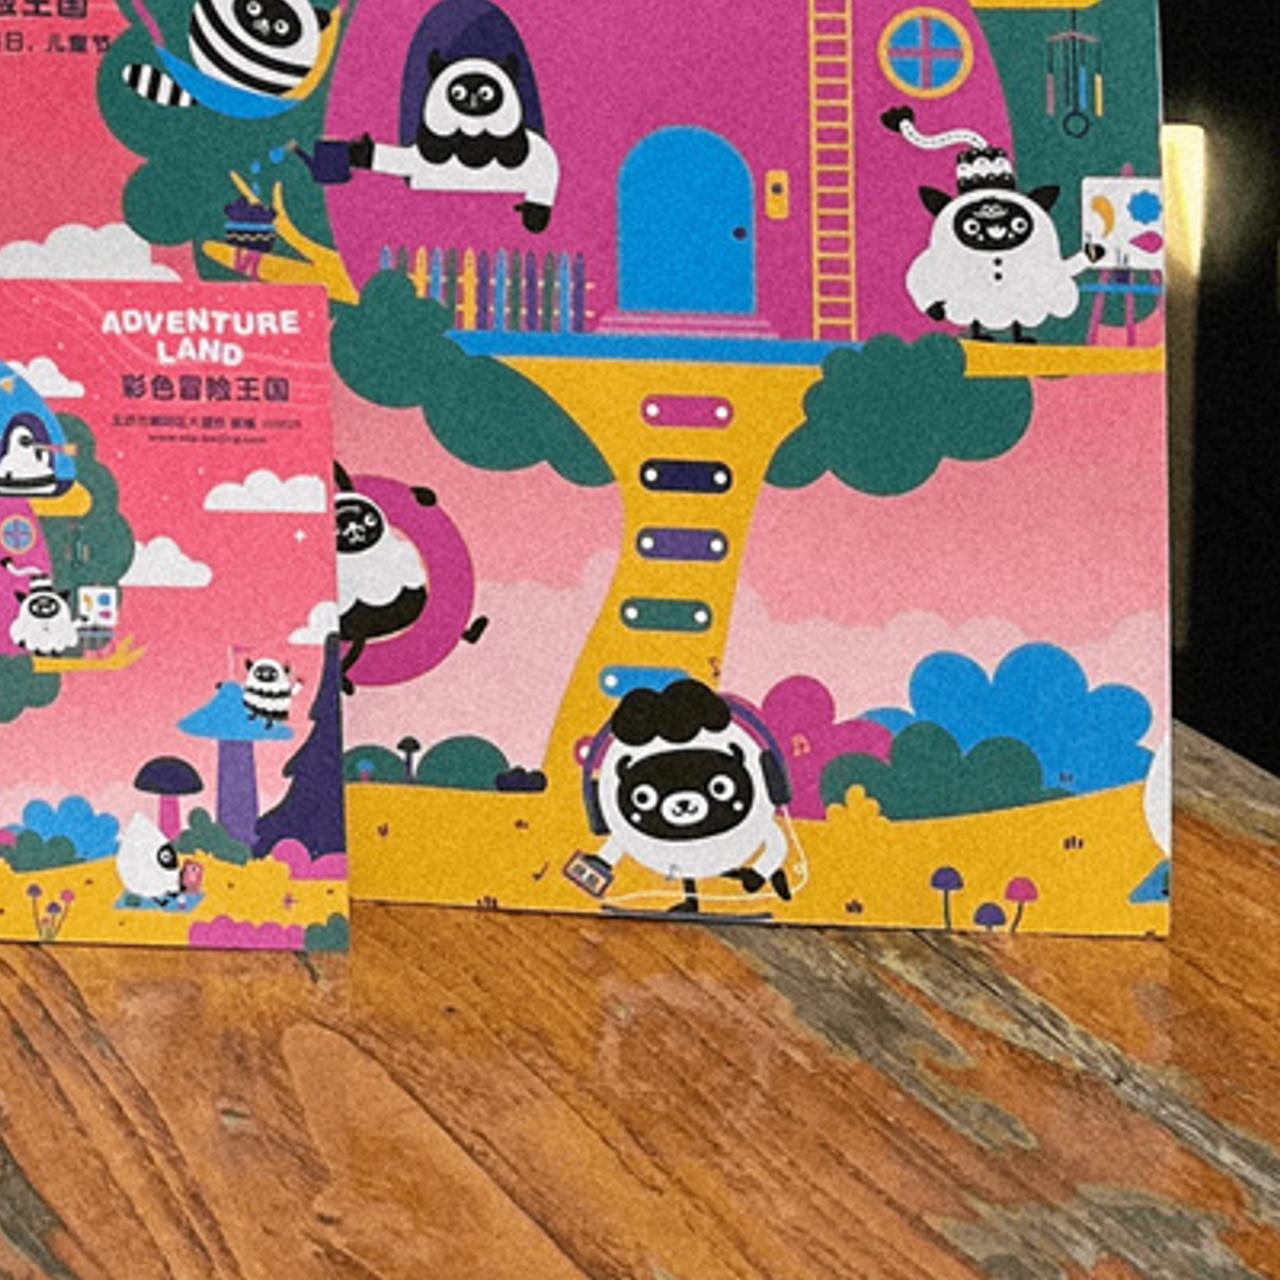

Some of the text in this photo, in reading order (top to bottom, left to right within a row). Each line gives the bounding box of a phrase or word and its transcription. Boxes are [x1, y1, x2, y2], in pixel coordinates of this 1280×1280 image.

[101, 307, 301, 336] ADVENTURE
[156, 337, 245, 367] LAND
[121, 373, 290, 402] 彩色冒险王国
